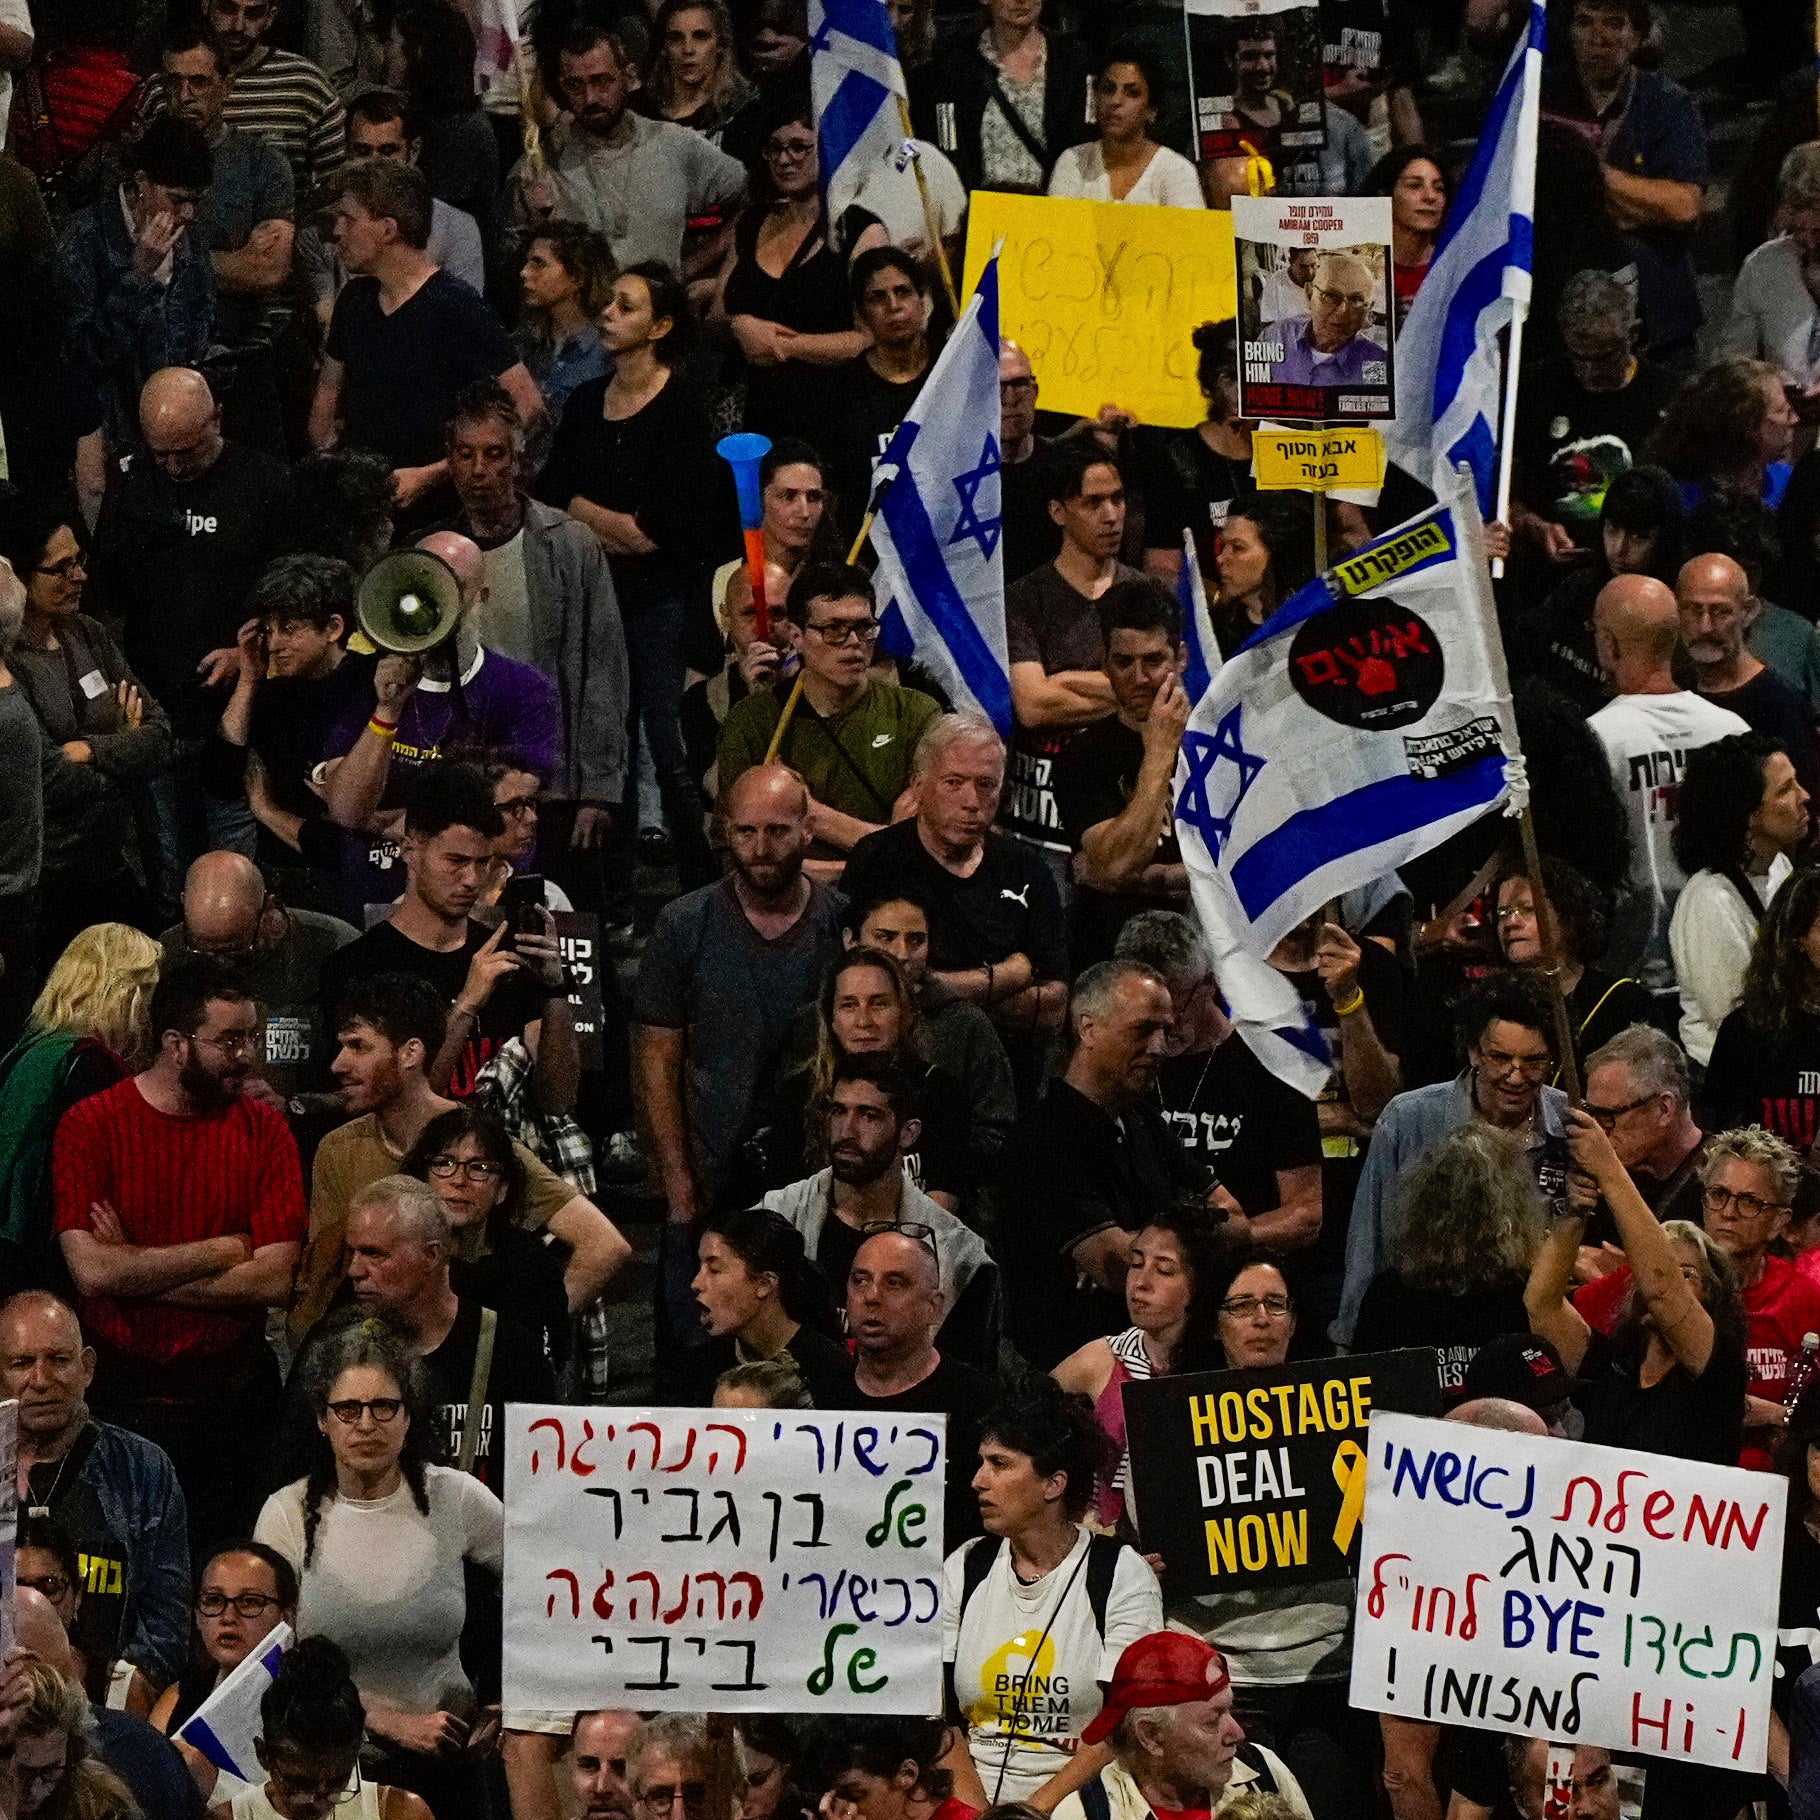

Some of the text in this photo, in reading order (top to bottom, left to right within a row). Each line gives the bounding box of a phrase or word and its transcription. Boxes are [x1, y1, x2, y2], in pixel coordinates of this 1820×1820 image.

[1244, 341, 1284, 363] BRING
[1245, 363, 1271, 383] HIM
[1276, 440, 1356, 460] אבא חטוף
[1302, 462, 1339, 478] בעזה
[1344, 530, 1440, 586] הופקרנו
[1189, 1377, 1372, 1448] HOSTAGE
[528, 1418, 749, 1477] הנהיגה
[773, 1420, 940, 1477] כישורי
[1197, 1446, 1306, 1507] DEAL
[582, 1479, 928, 1562] של בן גביר
[1383, 1439, 1769, 1552] ממשלת נאשמי
[1205, 1509, 1308, 1576] NOW
[1499, 1525, 1642, 1598] האג
[545, 1568, 940, 1625] ככישורי ההנהגה
[1367, 1552, 1491, 1640] לחו"ל
[1502, 1589, 1604, 1661] BYE
[590, 1624, 890, 1695] של ביבי
[1624, 1613, 1763, 1682] תגידו
[994, 1674, 1070, 1695] BRING
[994, 1695, 1070, 1714] THEM
[1422, 1663, 1599, 1735] למזומן
[997, 1715, 1070, 1733] HOME
